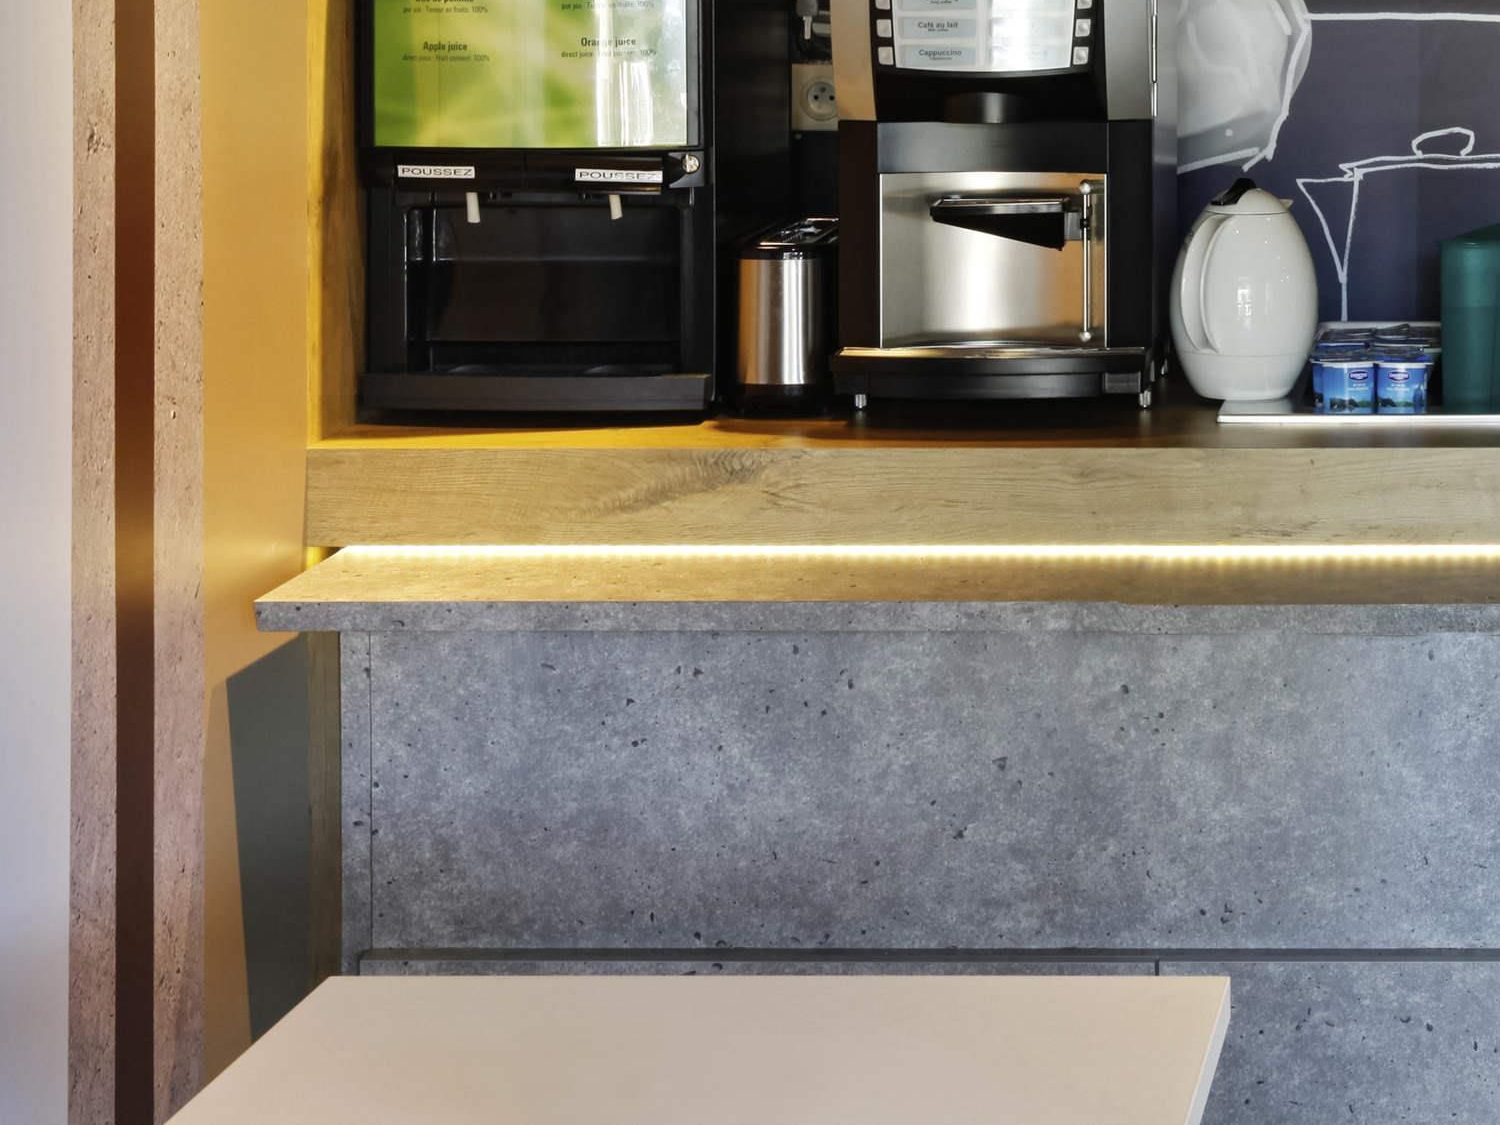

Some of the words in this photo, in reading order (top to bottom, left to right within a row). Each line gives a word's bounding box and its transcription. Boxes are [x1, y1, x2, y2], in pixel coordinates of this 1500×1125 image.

[917, 21, 934, 29] Café
[946, 21, 959, 29] lait
[423, 40, 446, 53] Apple
[447, 41, 468, 53] juice
[580, 37, 613, 48] Orae
[614, 37, 637, 49] juice
[918, 48, 963, 58] Cappuccino
[401, 167, 473, 177] POUSSEZ
[579, 170, 658, 181] POUSSEZ
